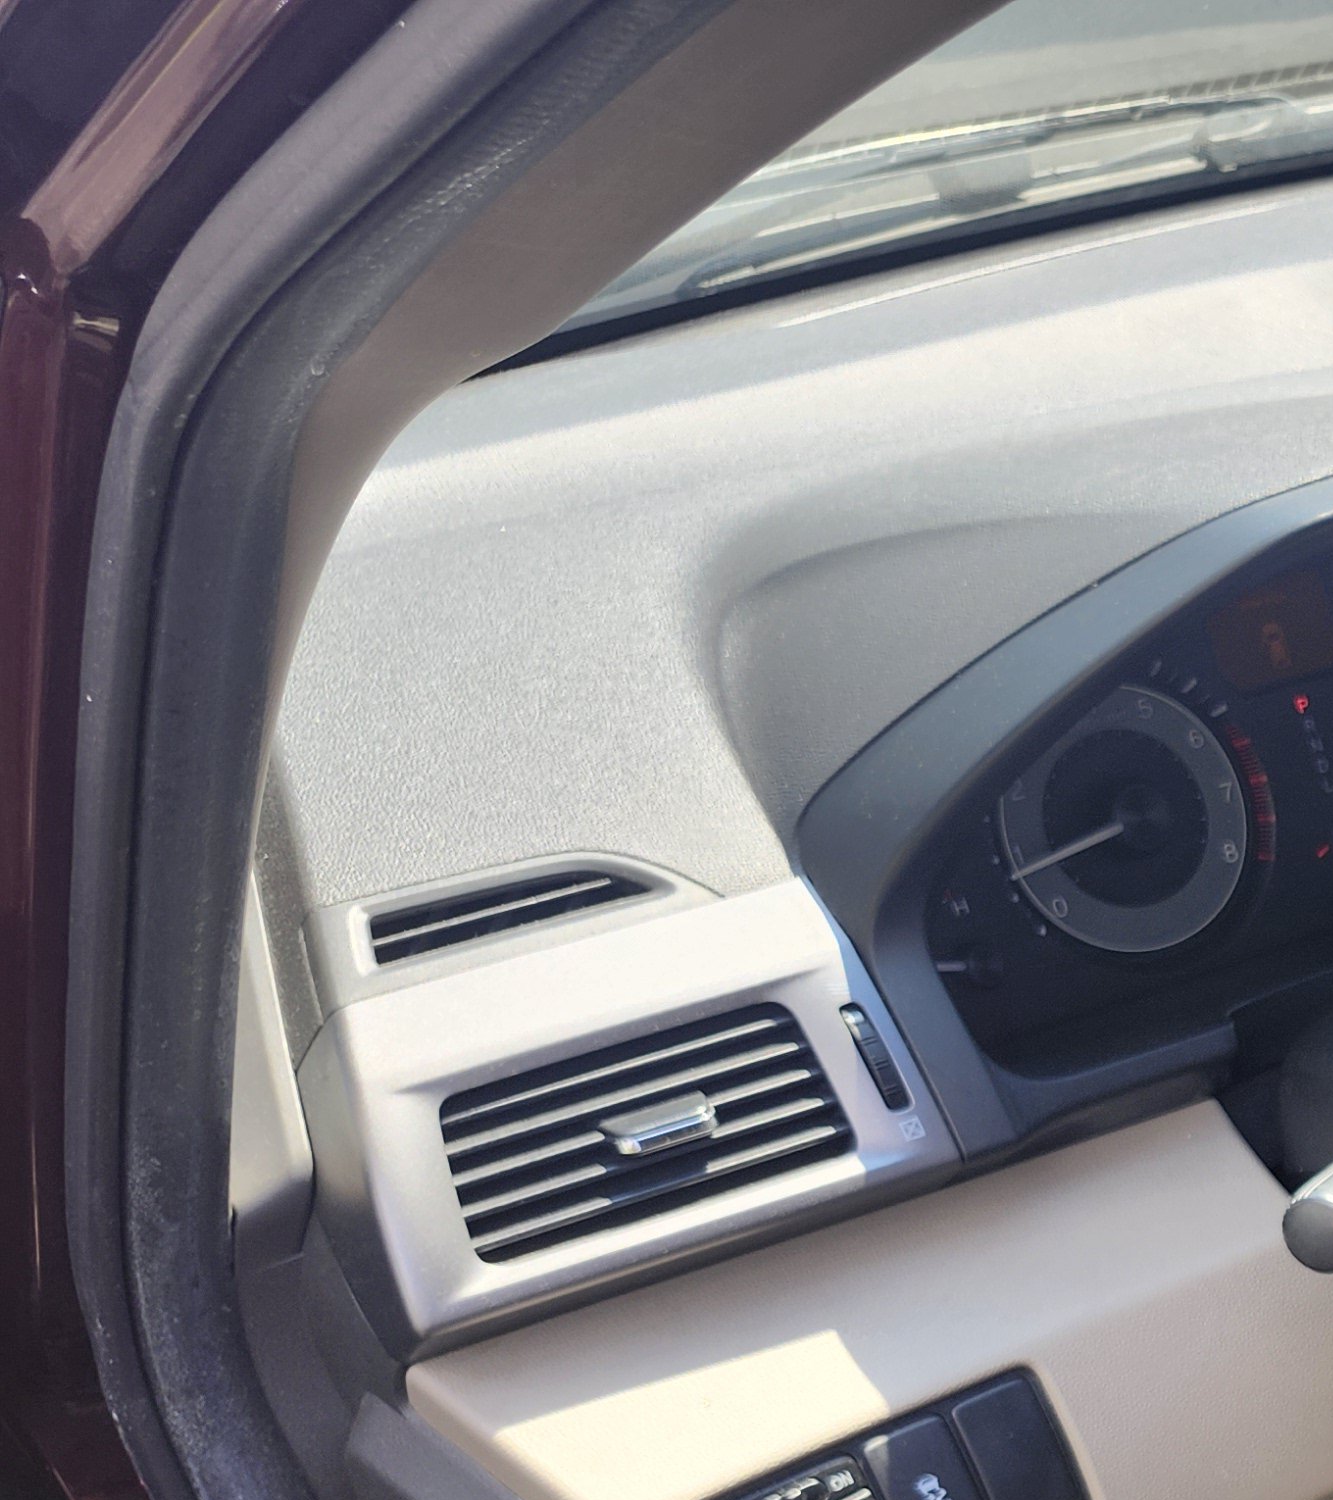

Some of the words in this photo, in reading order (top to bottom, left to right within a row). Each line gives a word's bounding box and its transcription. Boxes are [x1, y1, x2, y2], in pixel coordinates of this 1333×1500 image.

[1138, 701, 1154, 719] 5
[1293, 695, 1309, 715] P
[1190, 730, 1205, 749] 6
[1219, 782, 1234, 803] 7
[1222, 840, 1239, 863] 8
[1052, 899, 1069, 918] 0
[829, 1469, 855, 1492] ON
